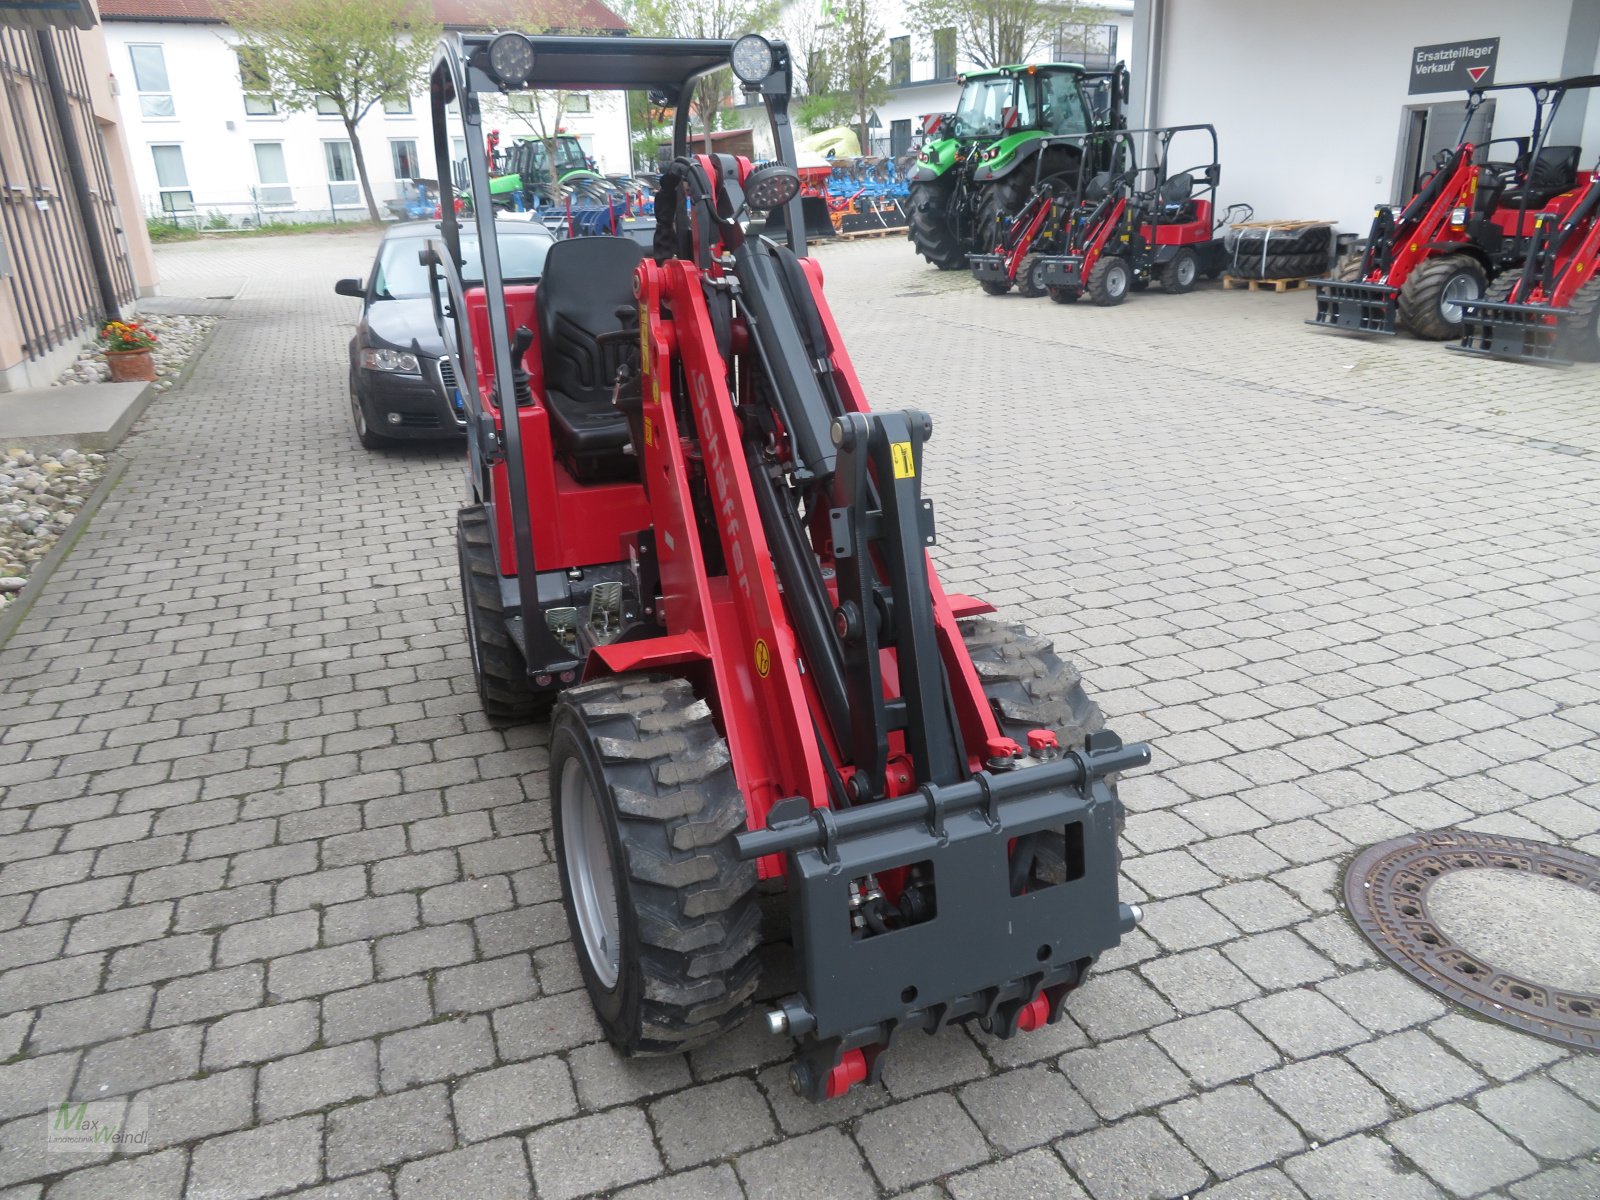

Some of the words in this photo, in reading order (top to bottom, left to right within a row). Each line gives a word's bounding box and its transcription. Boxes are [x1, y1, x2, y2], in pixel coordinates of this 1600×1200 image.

[1416, 46, 1493, 62] Ersatzteillager
[1415, 60, 1455, 75] Verkauf
[691, 369, 750, 597] Schäffer
